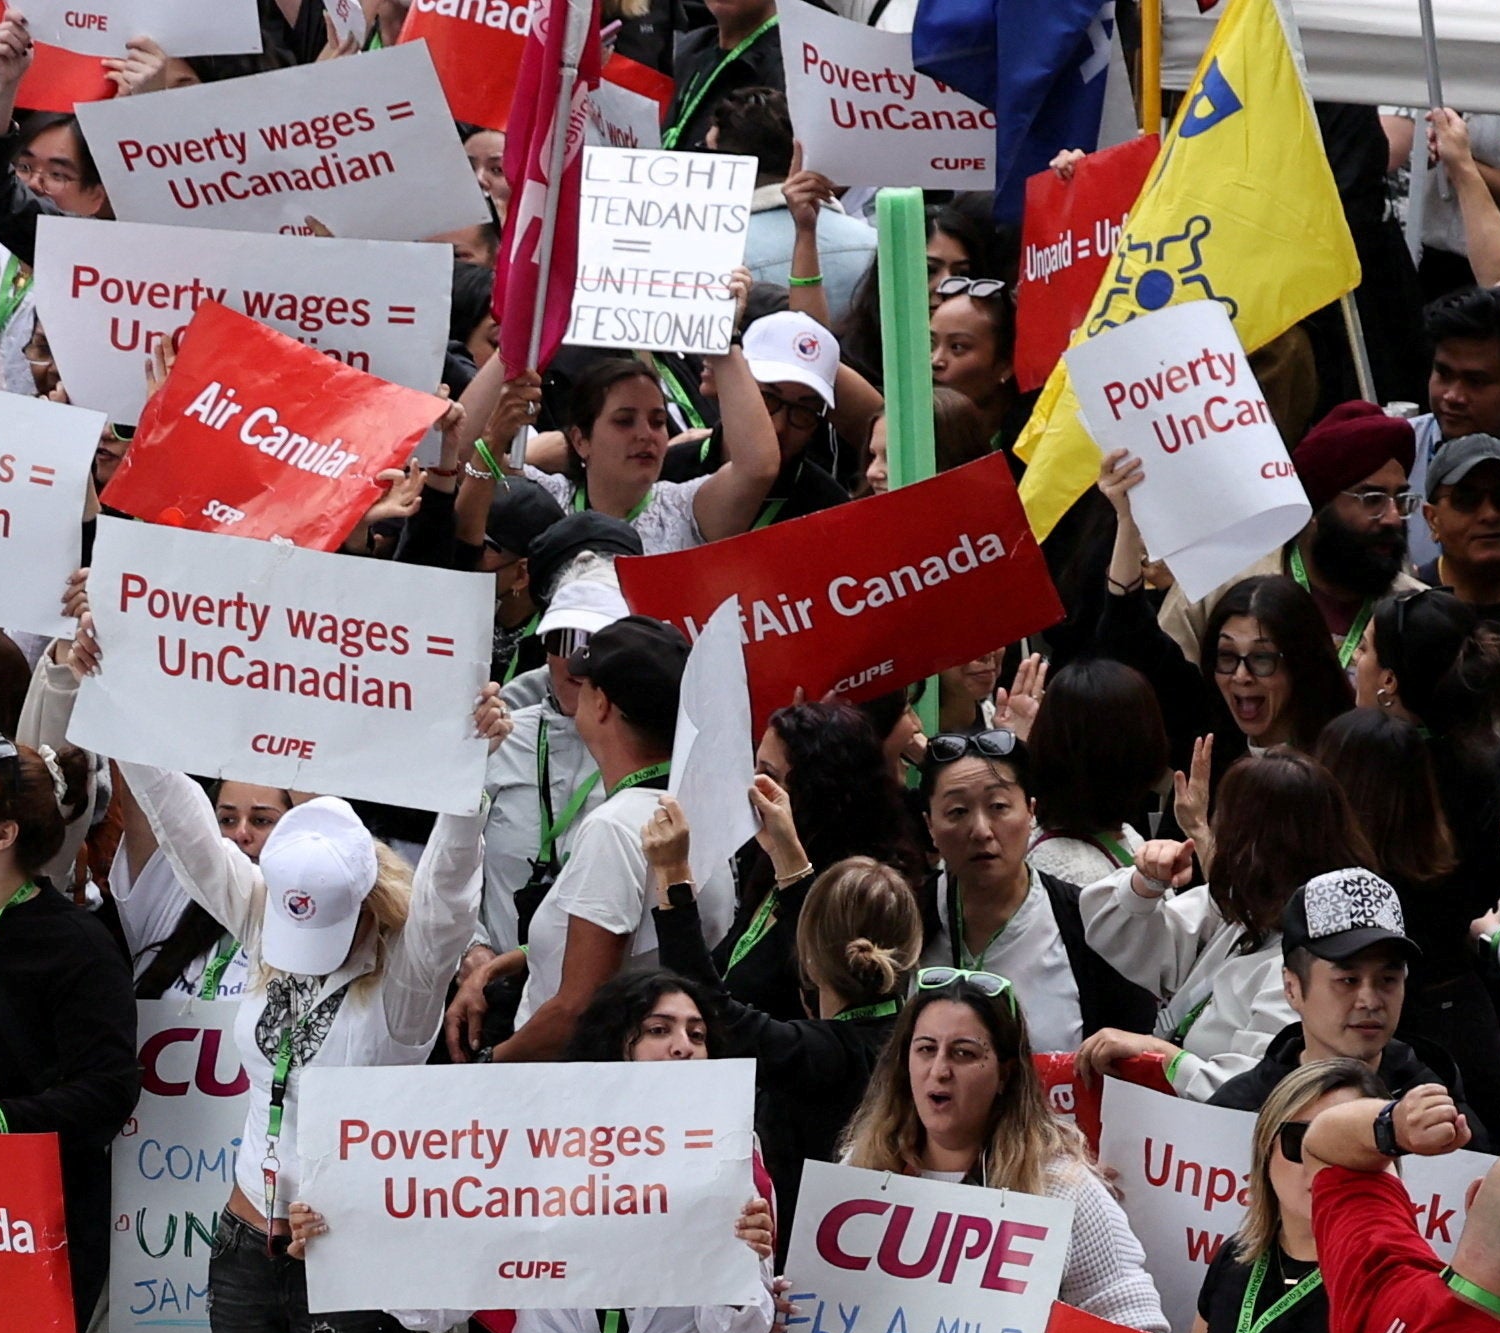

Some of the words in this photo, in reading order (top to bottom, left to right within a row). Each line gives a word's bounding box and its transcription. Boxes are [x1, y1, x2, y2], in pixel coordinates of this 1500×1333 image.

[64, 12, 108, 32] CUPE
[802, 42, 916, 98] Poverty
[117, 131, 247, 172] Poverty
[259, 106, 376, 148] wages
[387, 101, 415, 121] =
[169, 149, 395, 210] UnCanadian
[583, 155, 752, 192] LIGHT
[930, 158, 985, 171] CUPE
[613, 238, 652, 254] =
[1026, 229, 1072, 282] Unpaid
[1079, 238, 1090, 259] =
[72, 265, 227, 313] Poverty
[244, 286, 370, 330] wages
[388, 306, 415, 324] =
[1103, 346, 1237, 421] Poverty
[183, 380, 234, 430] Air
[239, 406, 360, 480] Canular
[29, 464, 55, 488] =
[827, 530, 1007, 618] Canada
[119, 572, 270, 642] Poverty
[286, 608, 410, 658] wages
[427, 633, 455, 658] =
[157, 634, 414, 712] UnCanadian
[834, 659, 895, 695] CUPE
[251, 733, 316, 761] CUPE
[339, 1119, 509, 1169] Poverty
[527, 1122, 666, 1167] wages
[684, 1128, 714, 1150] =
[384, 1175, 668, 1219] UnCanadian
[498, 1260, 567, 1279] CUPE
[816, 1198, 1049, 1295] CUPE
